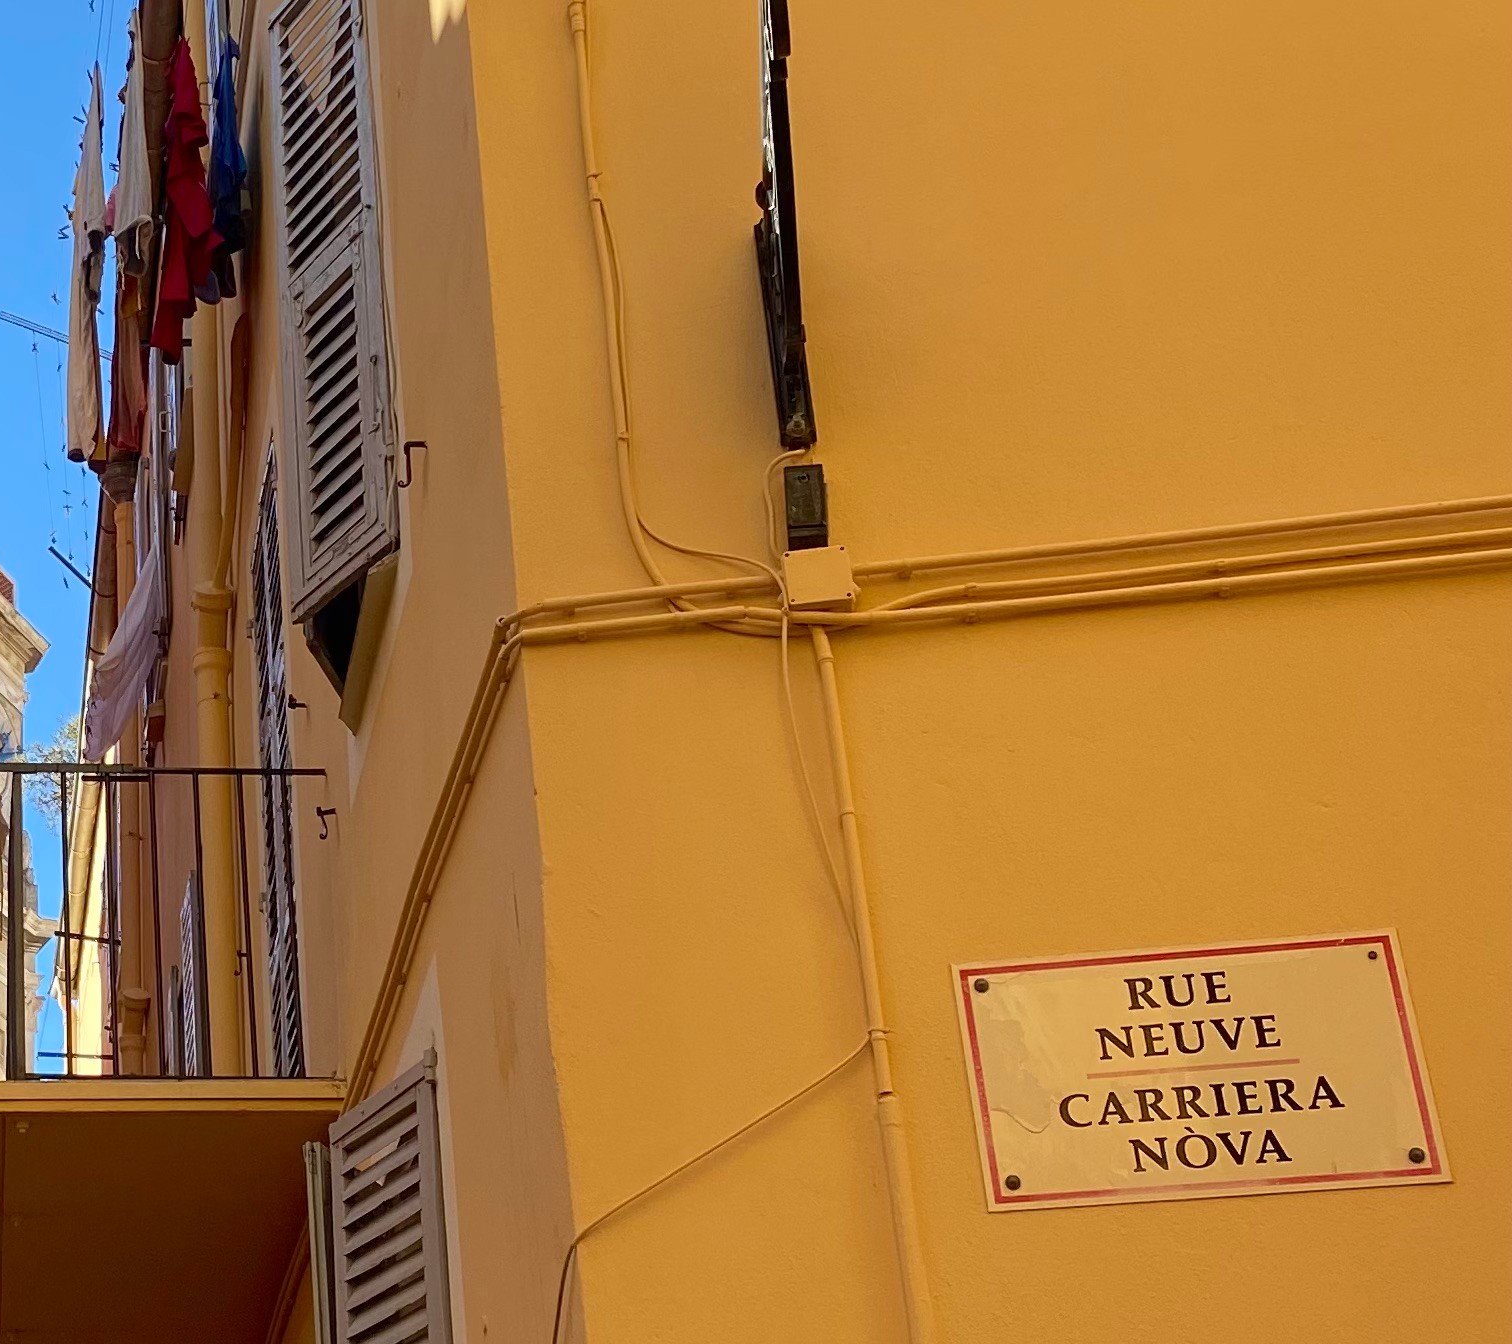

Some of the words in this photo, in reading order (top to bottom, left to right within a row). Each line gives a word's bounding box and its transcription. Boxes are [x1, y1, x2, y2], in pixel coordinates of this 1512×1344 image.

[1123, 970, 1232, 1011] RUE
[1094, 1013, 1283, 1061] NEUVE
[1058, 1074, 1346, 1129] CARRIERA
[1128, 1126, 1293, 1173] NÒVA
